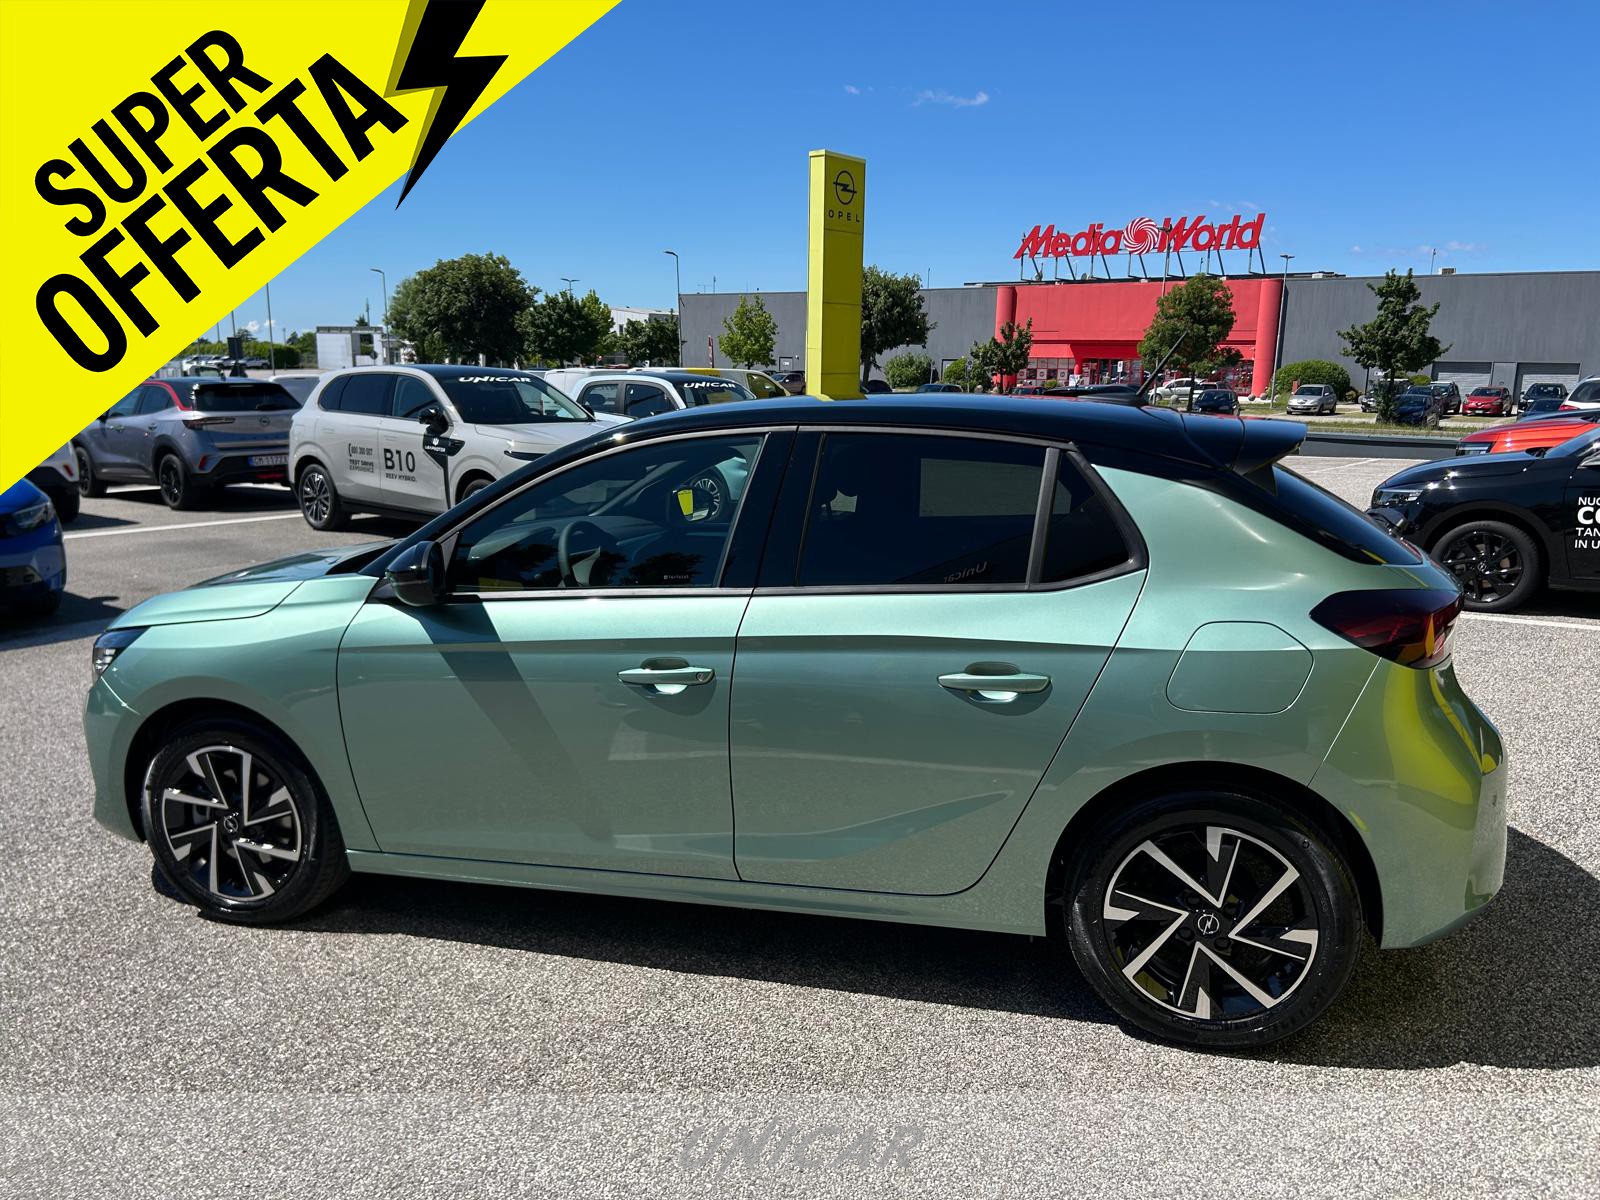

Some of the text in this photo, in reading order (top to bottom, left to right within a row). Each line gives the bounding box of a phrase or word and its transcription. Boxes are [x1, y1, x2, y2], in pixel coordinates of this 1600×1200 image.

[828, 209, 860, 223] OPEL
[1013, 213, 1266, 259] Media World
[459, 375, 532, 384] UNICAR
[683, 381, 737, 389] UNICAR
[383, 448, 416, 473] B10
[1577, 506, 1600, 525] C
[1574, 539, 1588, 549] IN
